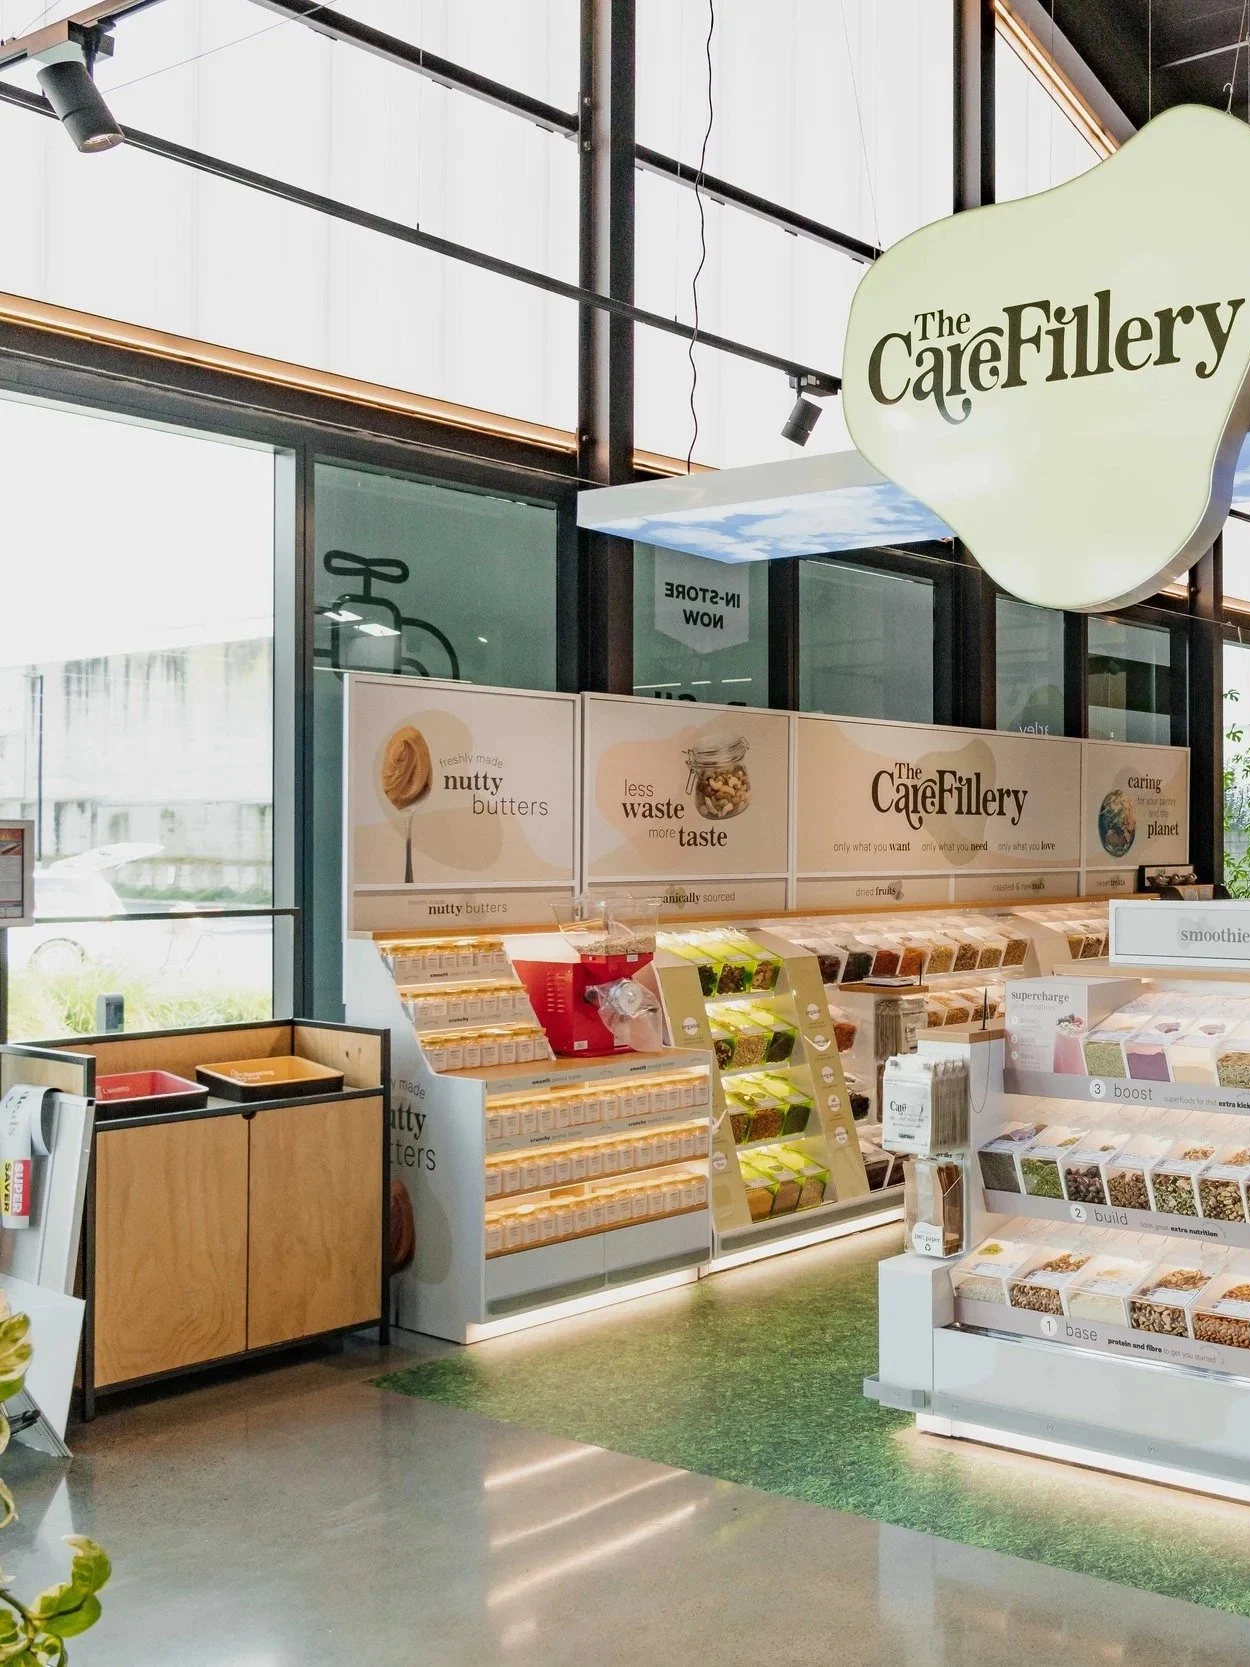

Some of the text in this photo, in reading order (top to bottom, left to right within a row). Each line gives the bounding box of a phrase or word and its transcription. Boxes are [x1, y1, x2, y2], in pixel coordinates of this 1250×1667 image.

[914, 310, 971, 341] The
[868, 289, 1246, 425] CareFillery
[439, 753, 504, 769] freshly made
[894, 762, 922, 780] The
[443, 771, 503, 796] nutty
[624, 778, 654, 797] less
[1128, 774, 1162, 793] caring
[473, 794, 548, 816] butters
[621, 798, 685, 820] waste
[871, 769, 1028, 831] CareFillery
[648, 826, 728, 847] more taste
[1147, 821, 1179, 838] planet
[833, 842, 911, 853] only what you want
[921, 841, 988, 853] only what you need
[997, 841, 1056, 853] only what you love
[703, 892, 736, 902] sourced
[855, 886, 896, 897] dried fruits
[428, 903, 463, 916] nutty
[465, 902, 508, 914] butters
[1180, 928, 1250, 944] smoothie
[1011, 992, 1069, 1004] supercharge
[400, 1079, 426, 1100] made
[1094, 1083, 1101, 1095] 3
[1114, 1083, 1153, 1100] boost
[1164, 1096, 1195, 1105] superfoods
[1236, 1101, 1250, 1109] kick
[13, 1162, 24, 1213] SUPER
[1075, 1207, 1082, 1219] 2
[1094, 1208, 1128, 1226] build
[1170, 1226, 1188, 1234] extra
[1189, 1228, 1218, 1237] nutrition
[1047, 1320, 1051, 1332] 1
[1066, 1322, 1097, 1342] base
[1108, 1338, 1132, 1348] protein
[1132, 1341, 1145, 1350] and
[1146, 1344, 1163, 1353] fibre
[1171, 1350, 1182, 1358] get
[1182, 1351, 1194, 1360] you
[1195, 1354, 1216, 1363] started
